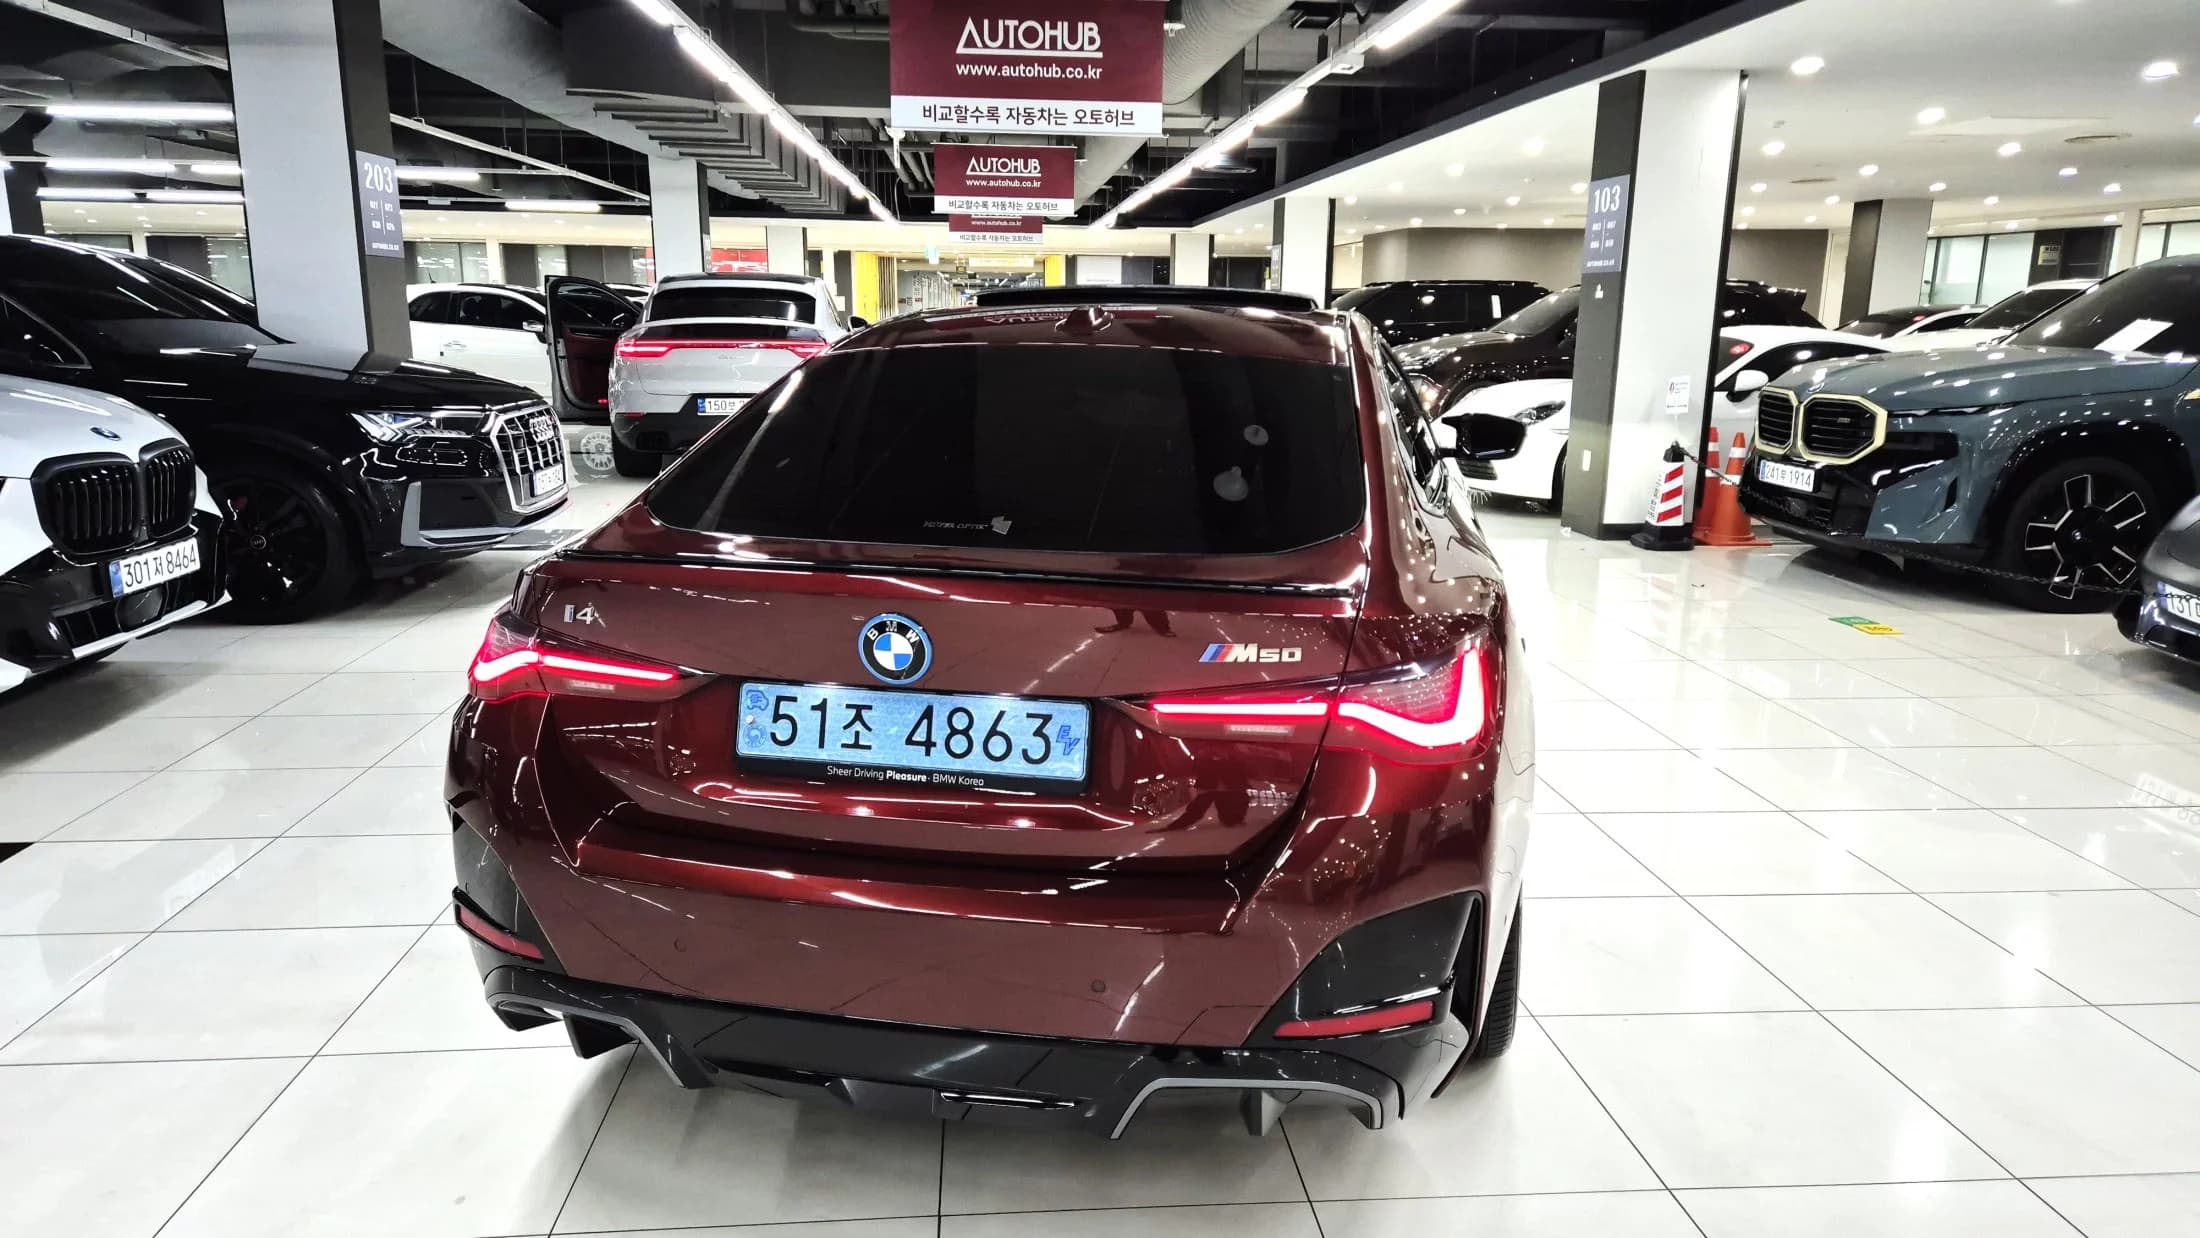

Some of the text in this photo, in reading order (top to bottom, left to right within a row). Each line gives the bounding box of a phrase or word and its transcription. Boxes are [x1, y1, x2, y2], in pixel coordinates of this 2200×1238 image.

[956, 16, 1103, 58] AUTOHUB
[955, 63, 1102, 80] www.autohub.co.kr
[922, 104, 1135, 127] 비교할수록 자동차는 오토허브
[966, 156, 1041, 177] AUTOHUB
[364, 161, 394, 194] 203
[965, 179, 1041, 188] www.autohub.co.kr
[949, 199, 1058, 211] 비교할수록 자동차는 오토허브
[1594, 184, 1621, 214] 103
[1789, 468, 1812, 488] 1914
[123, 543, 197, 588] 301저 8464
[866, 621, 920, 643] BMW
[1222, 643, 1302, 663] M50
[769, 695, 1080, 765] 51조 4863 EV
[826, 765, 984, 786] Sheer Driving Pleasure BMW Korea
